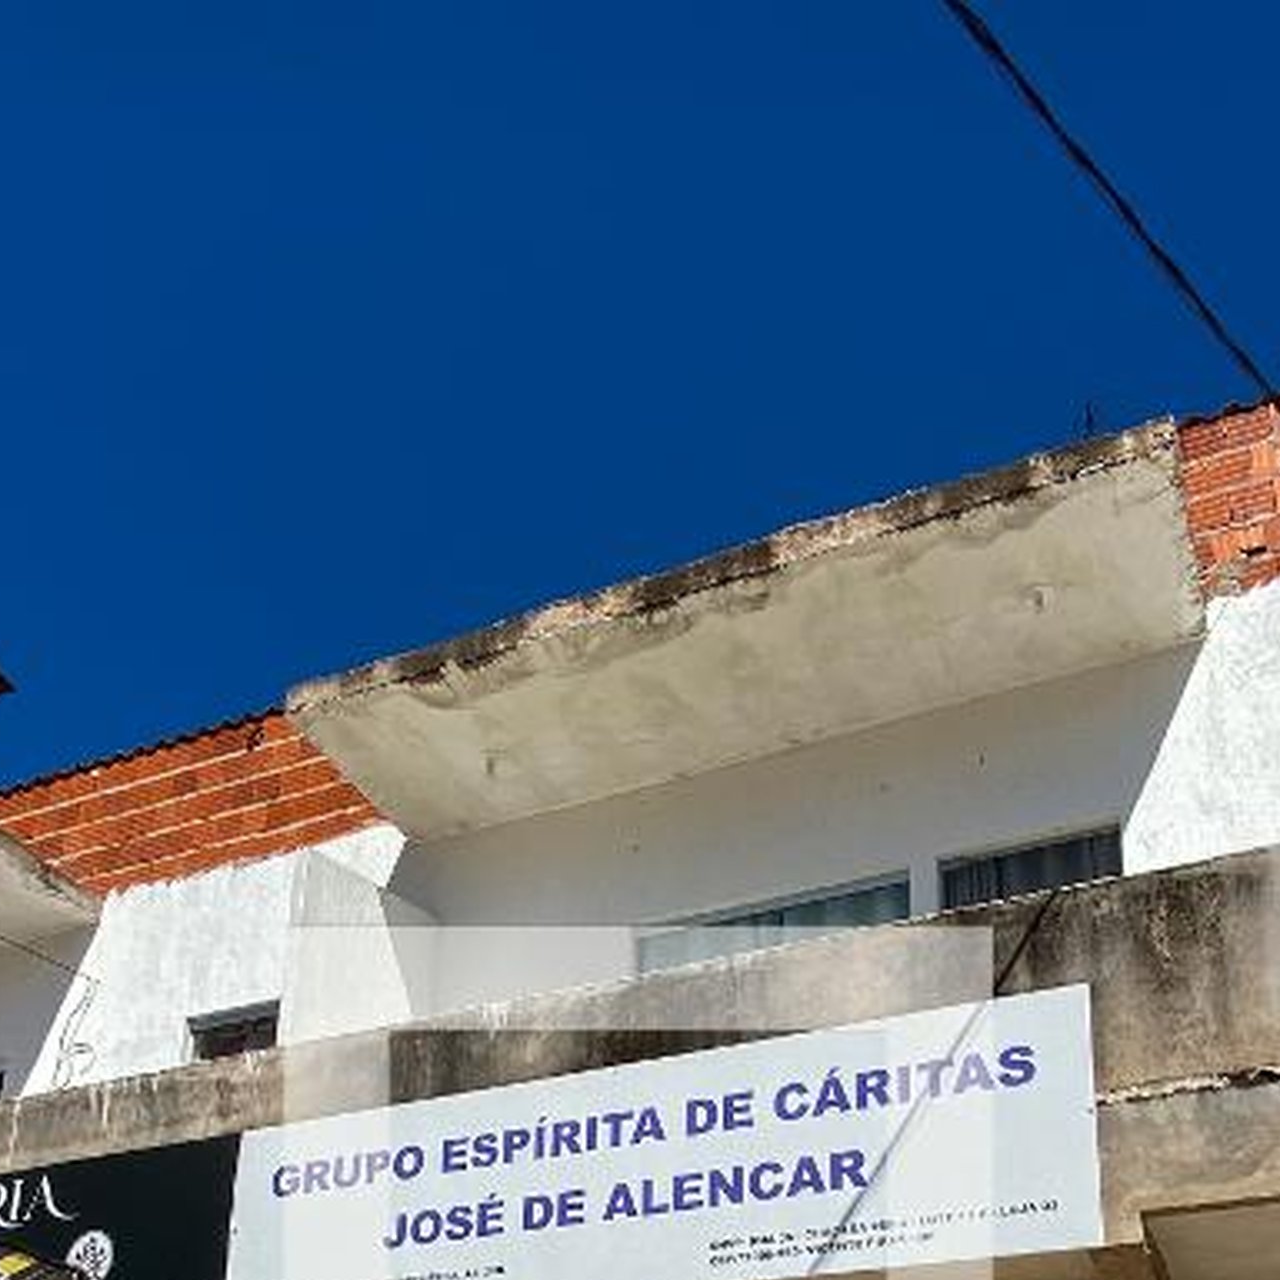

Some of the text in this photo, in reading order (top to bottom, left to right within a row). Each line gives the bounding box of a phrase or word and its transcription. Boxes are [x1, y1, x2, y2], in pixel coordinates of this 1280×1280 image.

[272, 1045, 1037, 1198] GRUPO ESPÍRITA DE CÁRITAS
[382, 1149, 869, 1249] JOSÉ DE ALENCAR
